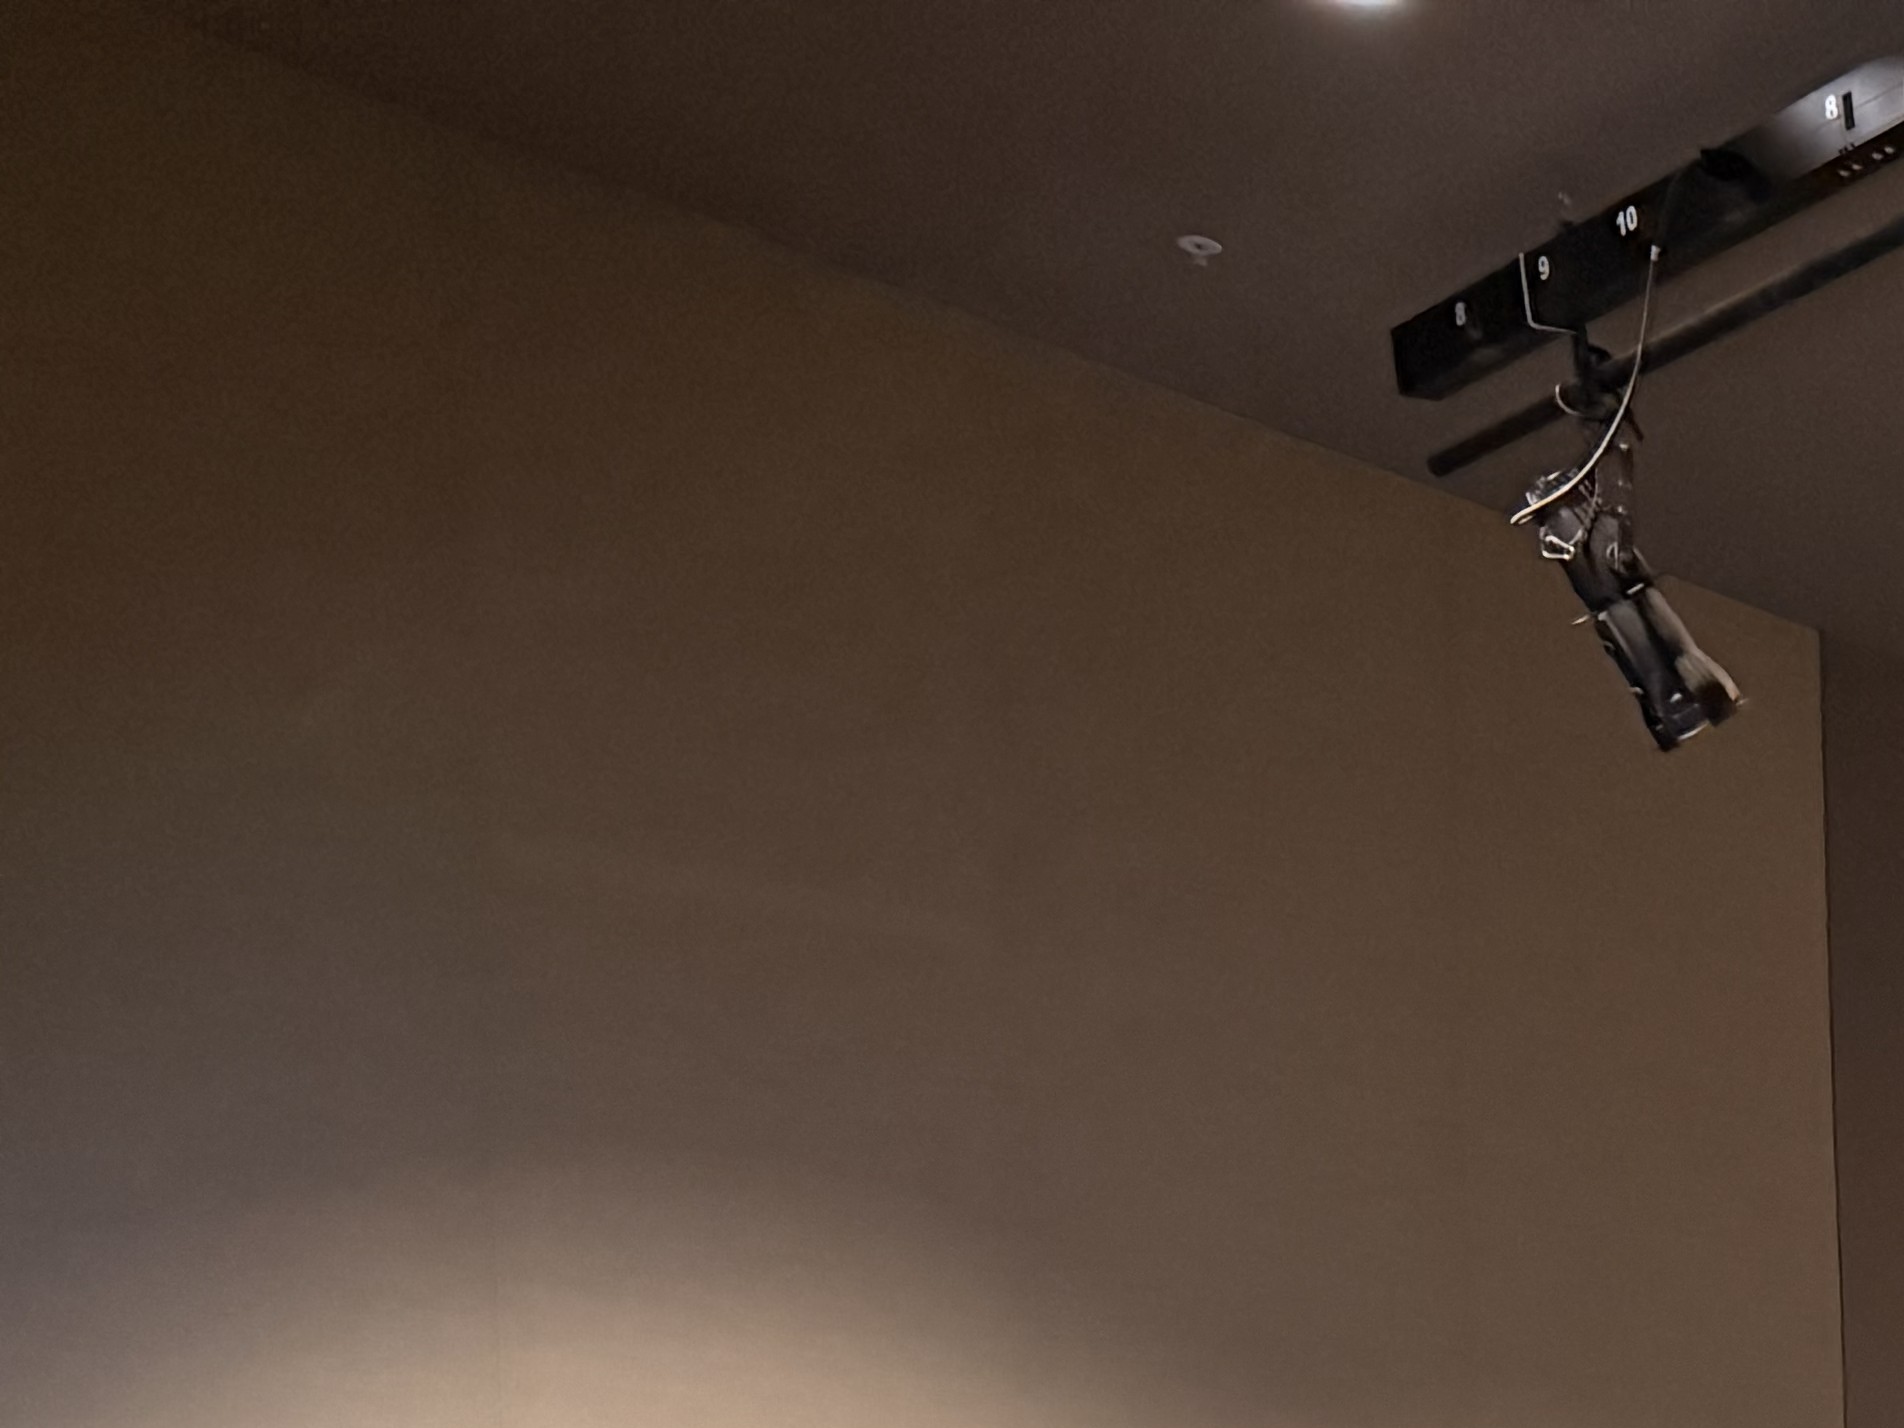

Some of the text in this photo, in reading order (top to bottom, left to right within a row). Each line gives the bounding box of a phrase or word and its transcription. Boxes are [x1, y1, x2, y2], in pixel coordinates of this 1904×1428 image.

[1824, 94, 1838, 121] 8
[1614, 204, 1639, 237] 10
[1537, 254, 1550, 281] 9
